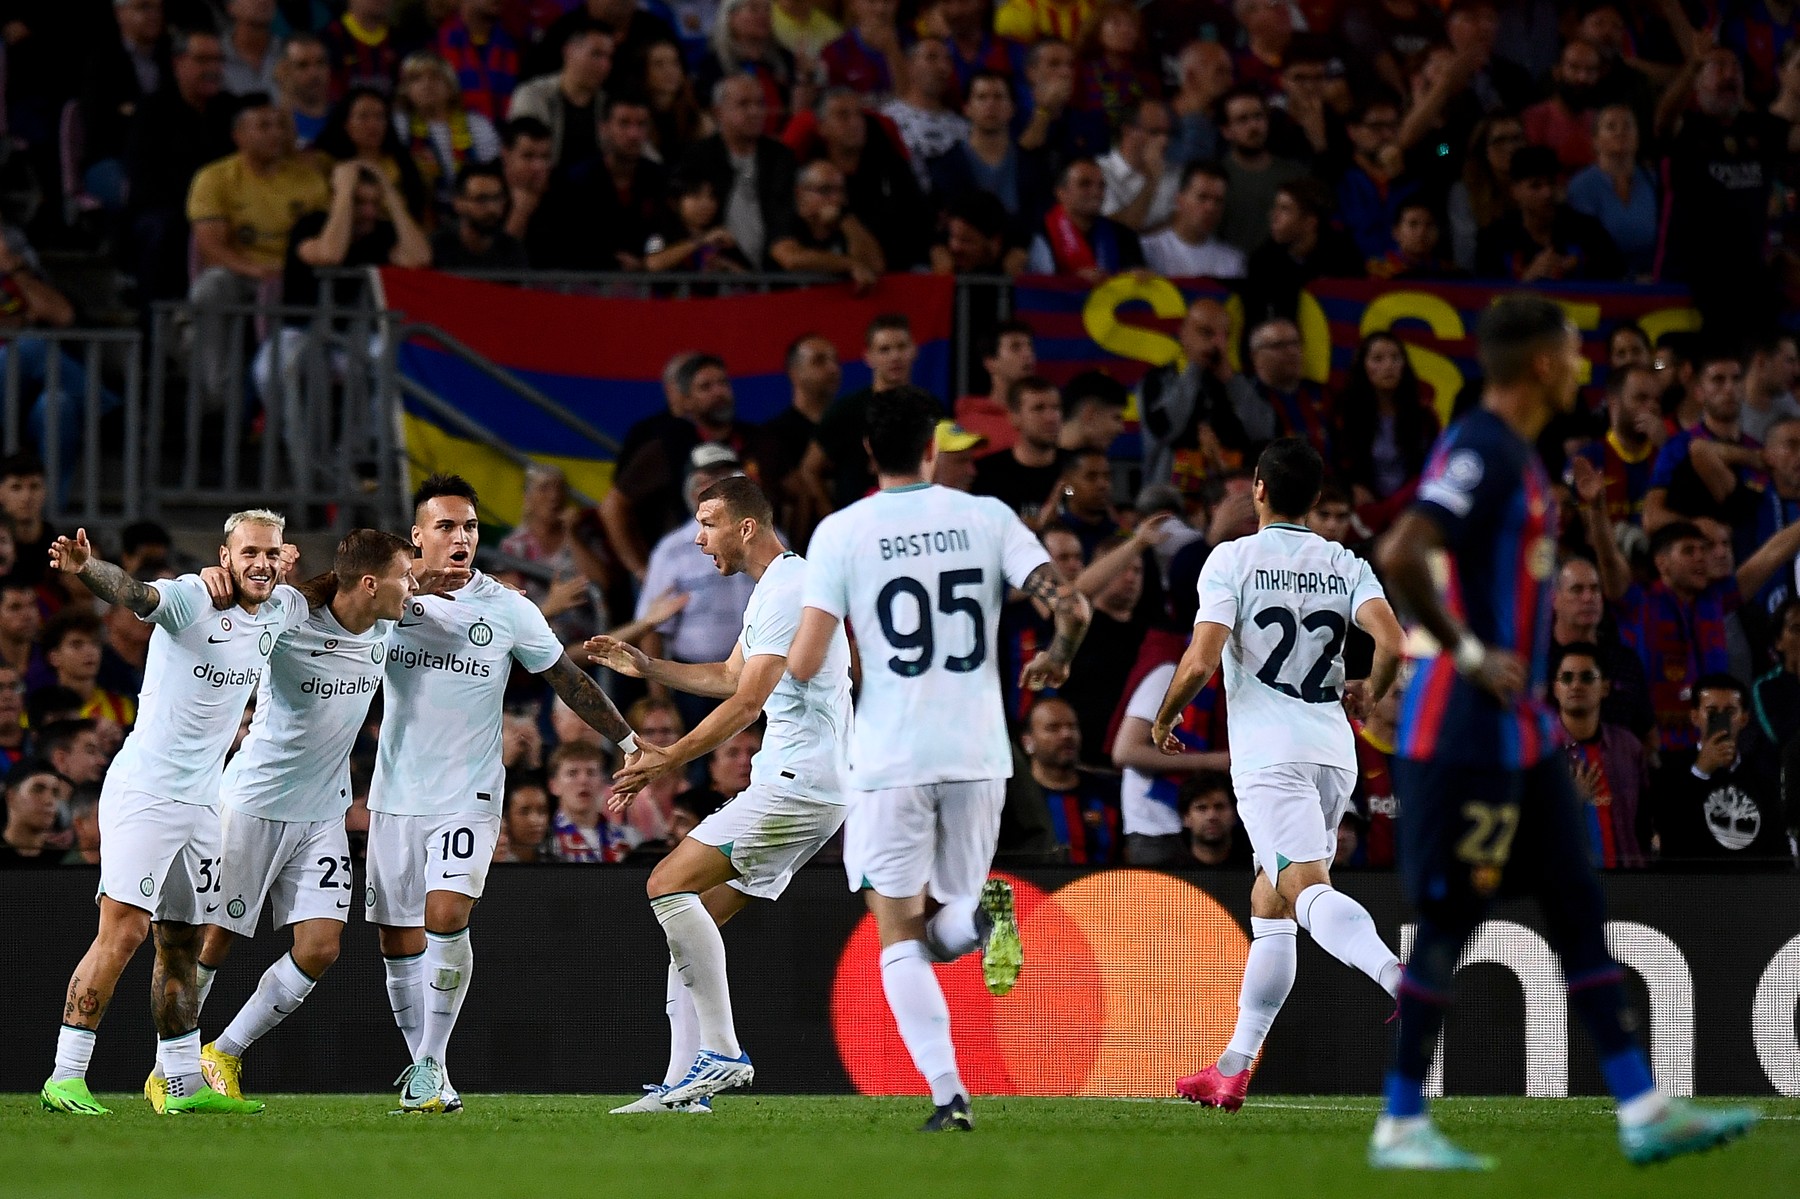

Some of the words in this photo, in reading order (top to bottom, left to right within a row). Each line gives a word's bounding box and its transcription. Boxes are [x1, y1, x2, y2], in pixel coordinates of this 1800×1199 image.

[879, 529, 970, 561] BASTONI
[877, 567, 985, 678] 95
[389, 644, 490, 678] digitalbits
[1253, 606, 1346, 704] 22
[300, 675, 379, 699] digitalbit
[441, 827, 475, 860] 10
[1455, 800, 1521, 866] 27
